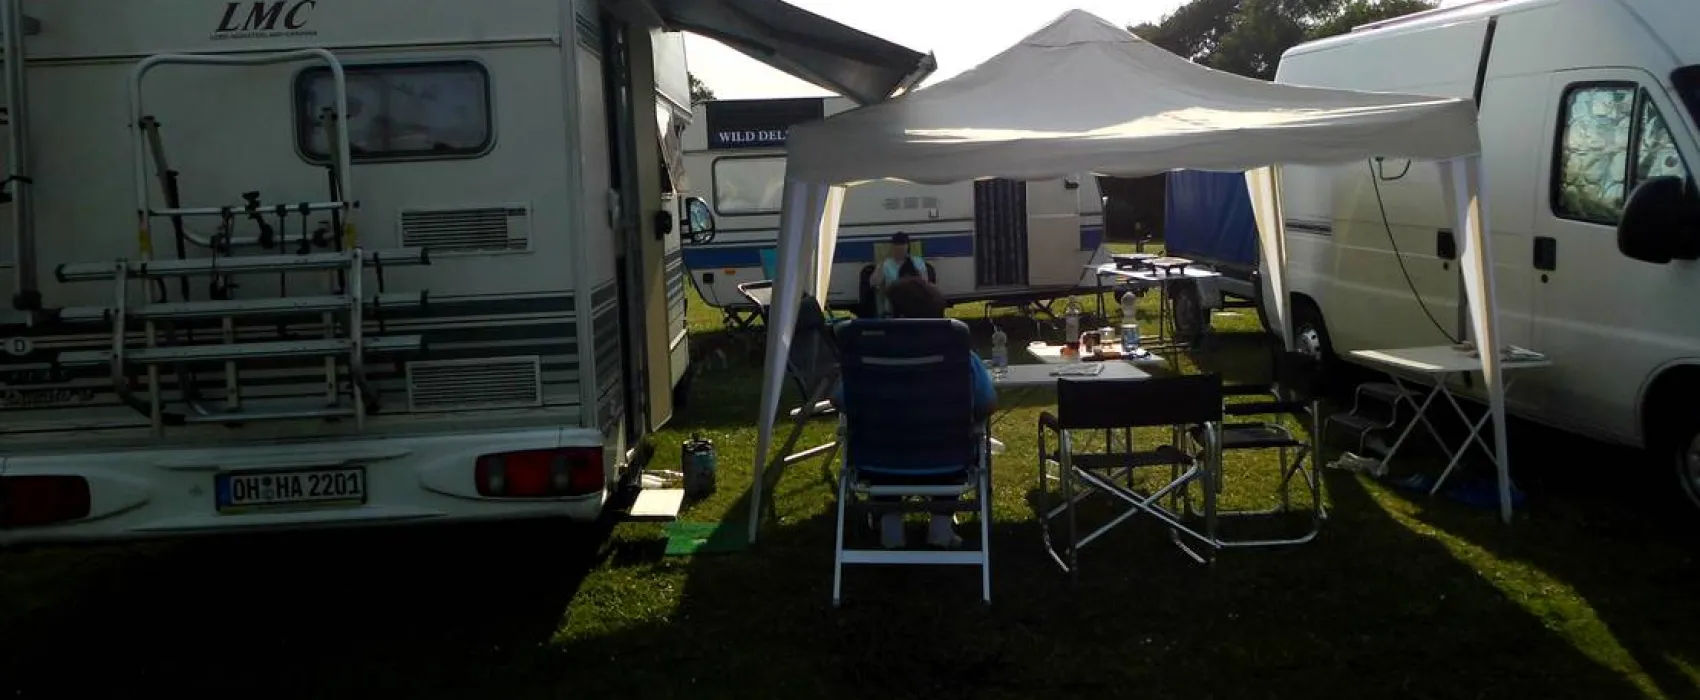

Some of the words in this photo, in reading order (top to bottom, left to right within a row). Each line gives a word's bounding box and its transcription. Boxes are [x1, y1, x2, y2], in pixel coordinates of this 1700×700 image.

[215, 0, 316, 32] LMC
[719, 130, 756, 142] WILD
[758, 129, 789, 141] DEL
[14, 339, 25, 353] D
[233, 478, 260, 500] OH
[276, 475, 302, 498] HA
[308, 471, 361, 497] 2201
